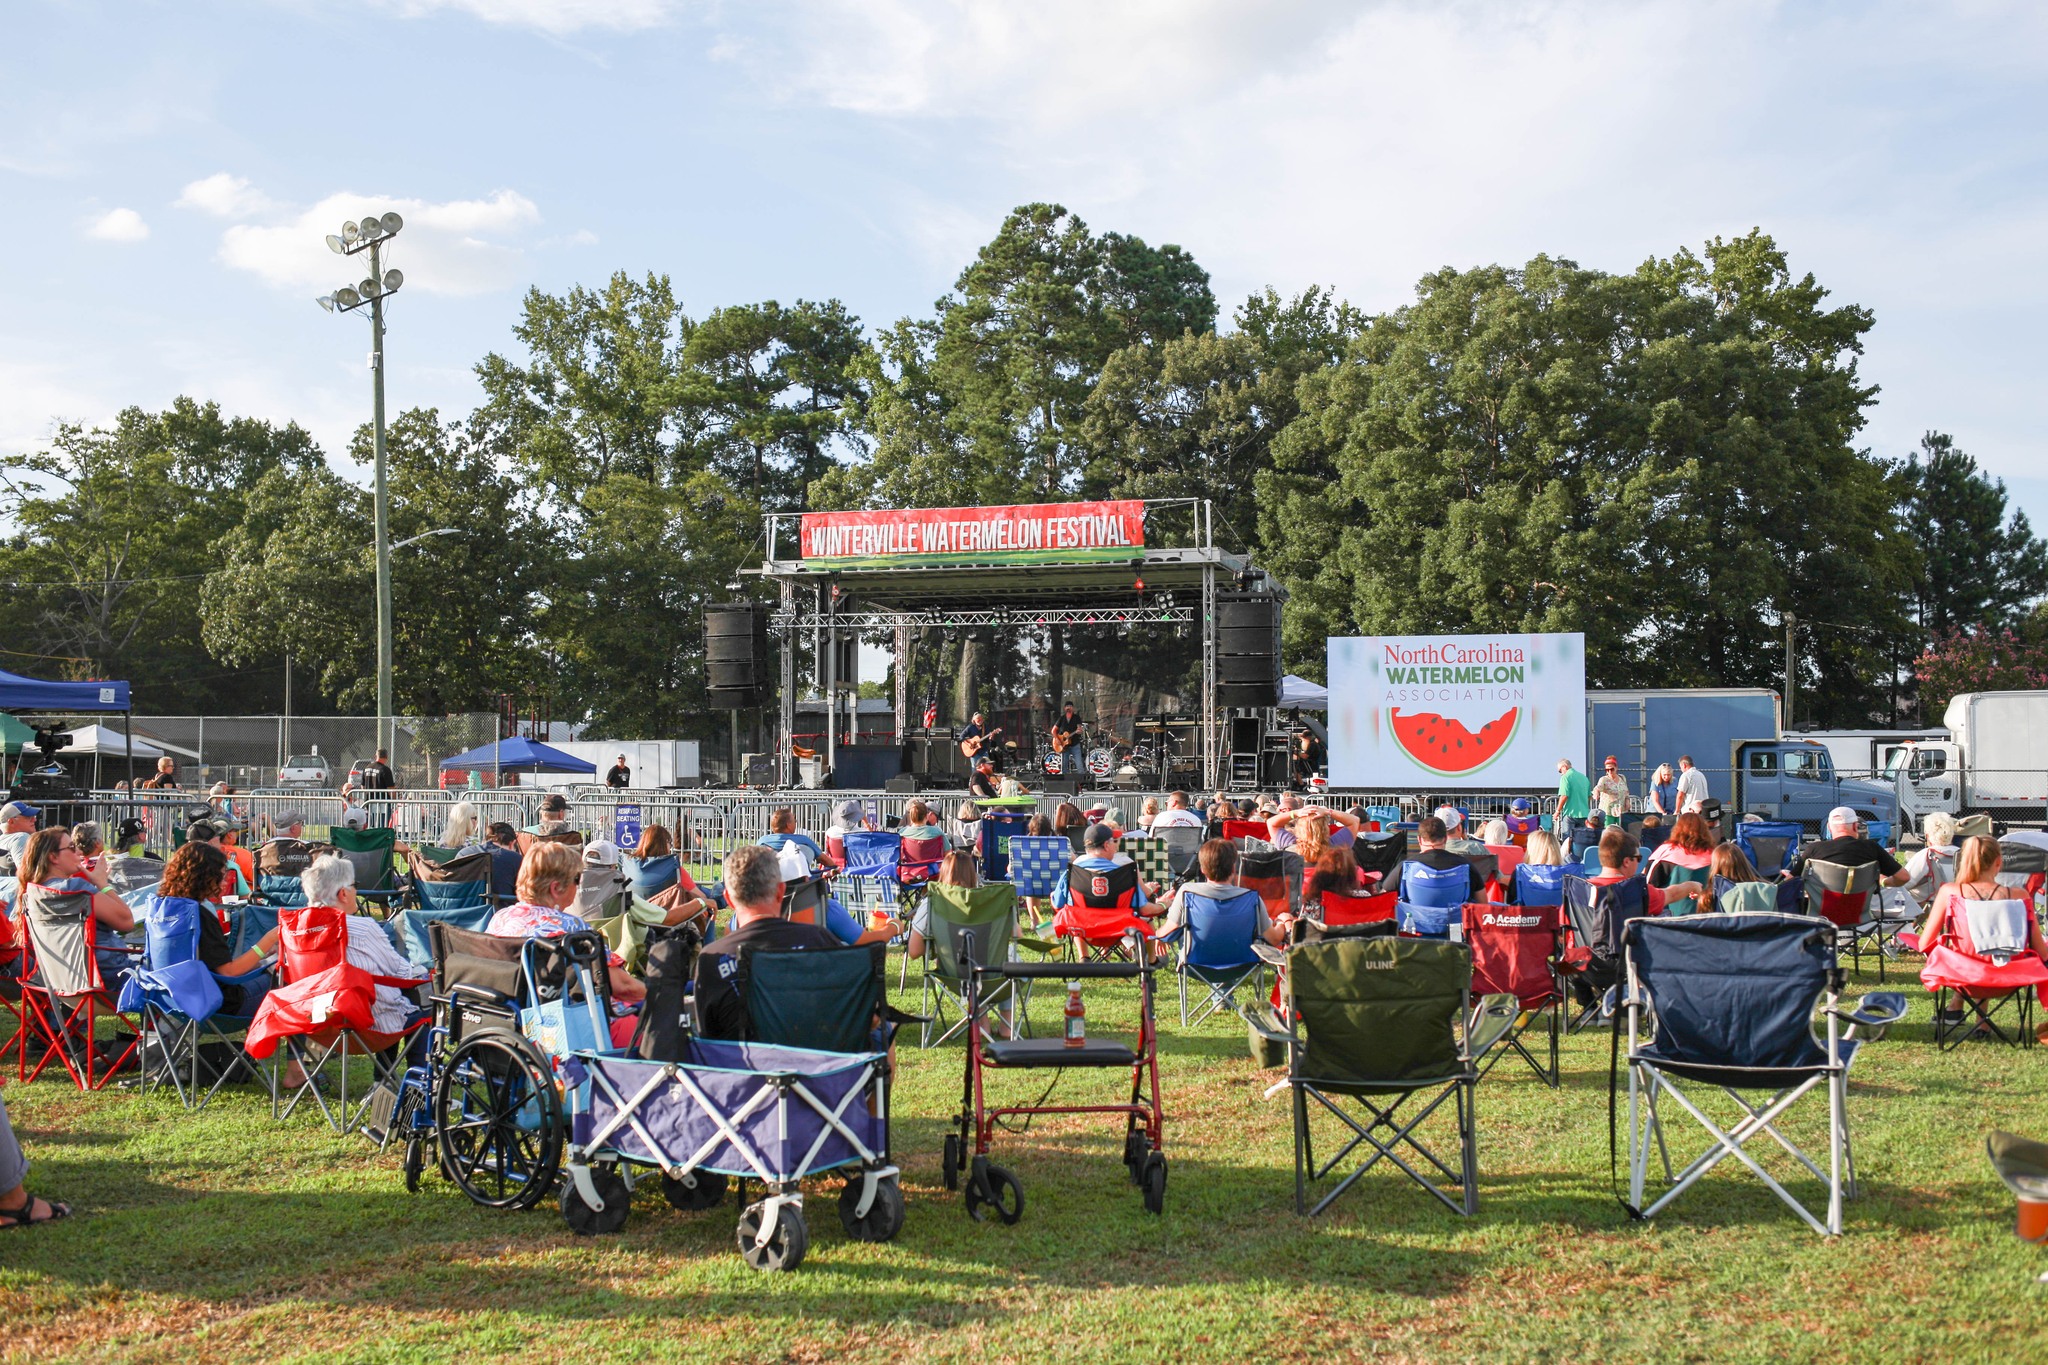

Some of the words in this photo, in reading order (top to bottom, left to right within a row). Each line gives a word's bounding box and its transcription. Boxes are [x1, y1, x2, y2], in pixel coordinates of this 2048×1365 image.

[810, 522, 919, 556] WINTERVILLE
[921, 518, 1043, 552] WATERMELON
[1046, 514, 1131, 548] FESTIVAL
[1385, 666, 1525, 685] WATERMELON
[1385, 688, 1525, 702] ASSOCIATION
[617, 807, 640, 815] RESERVED
[1496, 914, 1542, 926] Academy
[1365, 960, 1396, 970] ULINE
[462, 1011, 482, 1024] drive
